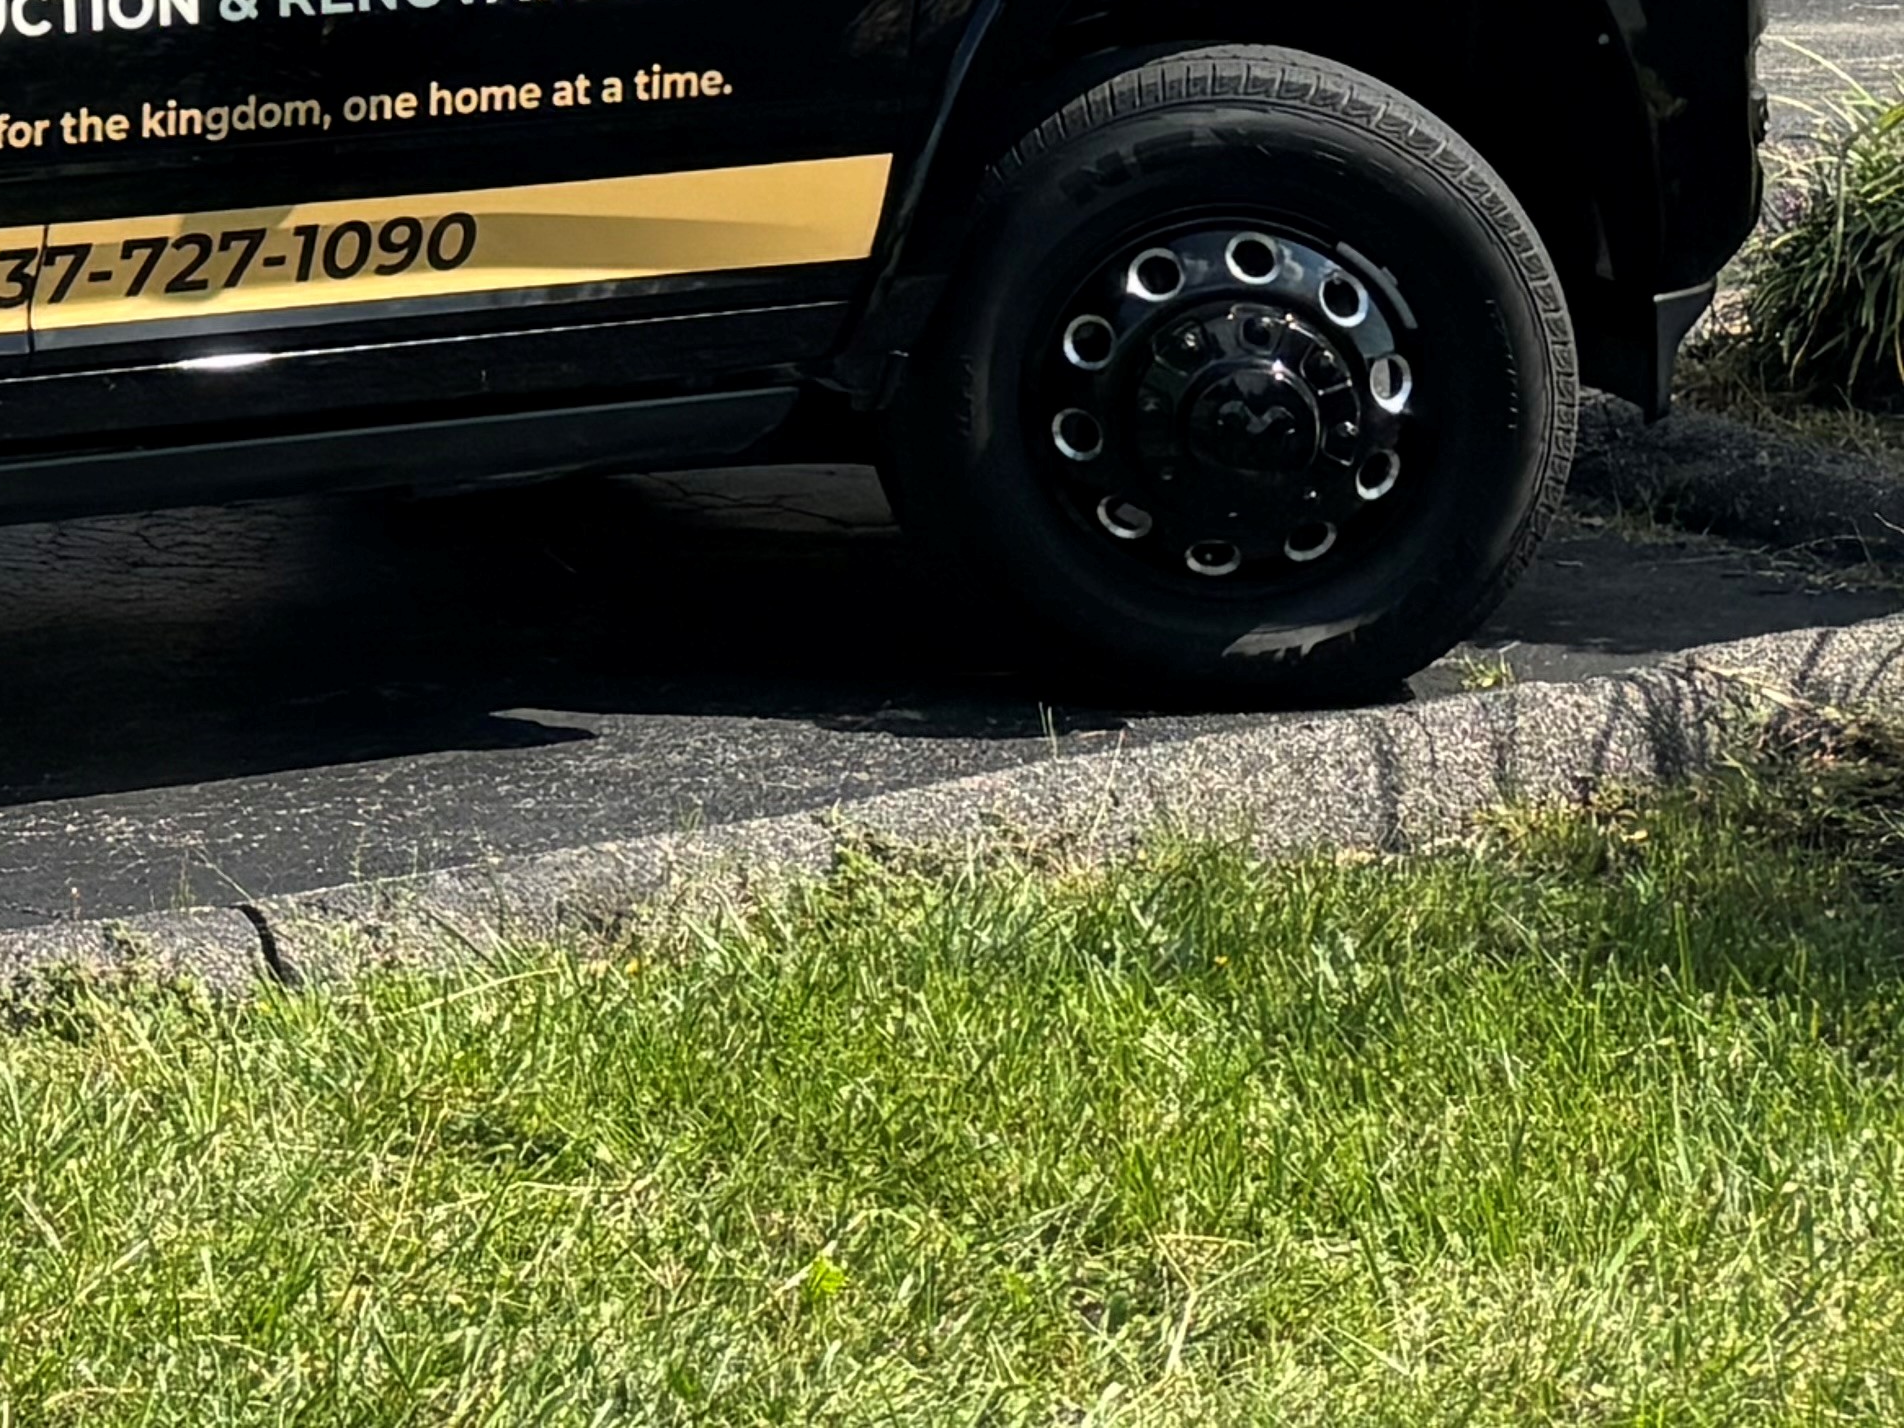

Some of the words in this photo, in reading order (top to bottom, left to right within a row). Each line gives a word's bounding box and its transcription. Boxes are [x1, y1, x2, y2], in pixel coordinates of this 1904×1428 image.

[60, 107, 131, 144] the
[141, 99, 333, 141] kingdom,
[342, 90, 419, 124] one
[428, 82, 543, 117] home
[552, 75, 592, 107] at
[601, 75, 624, 104] a
[633, 63, 734, 103] time.
